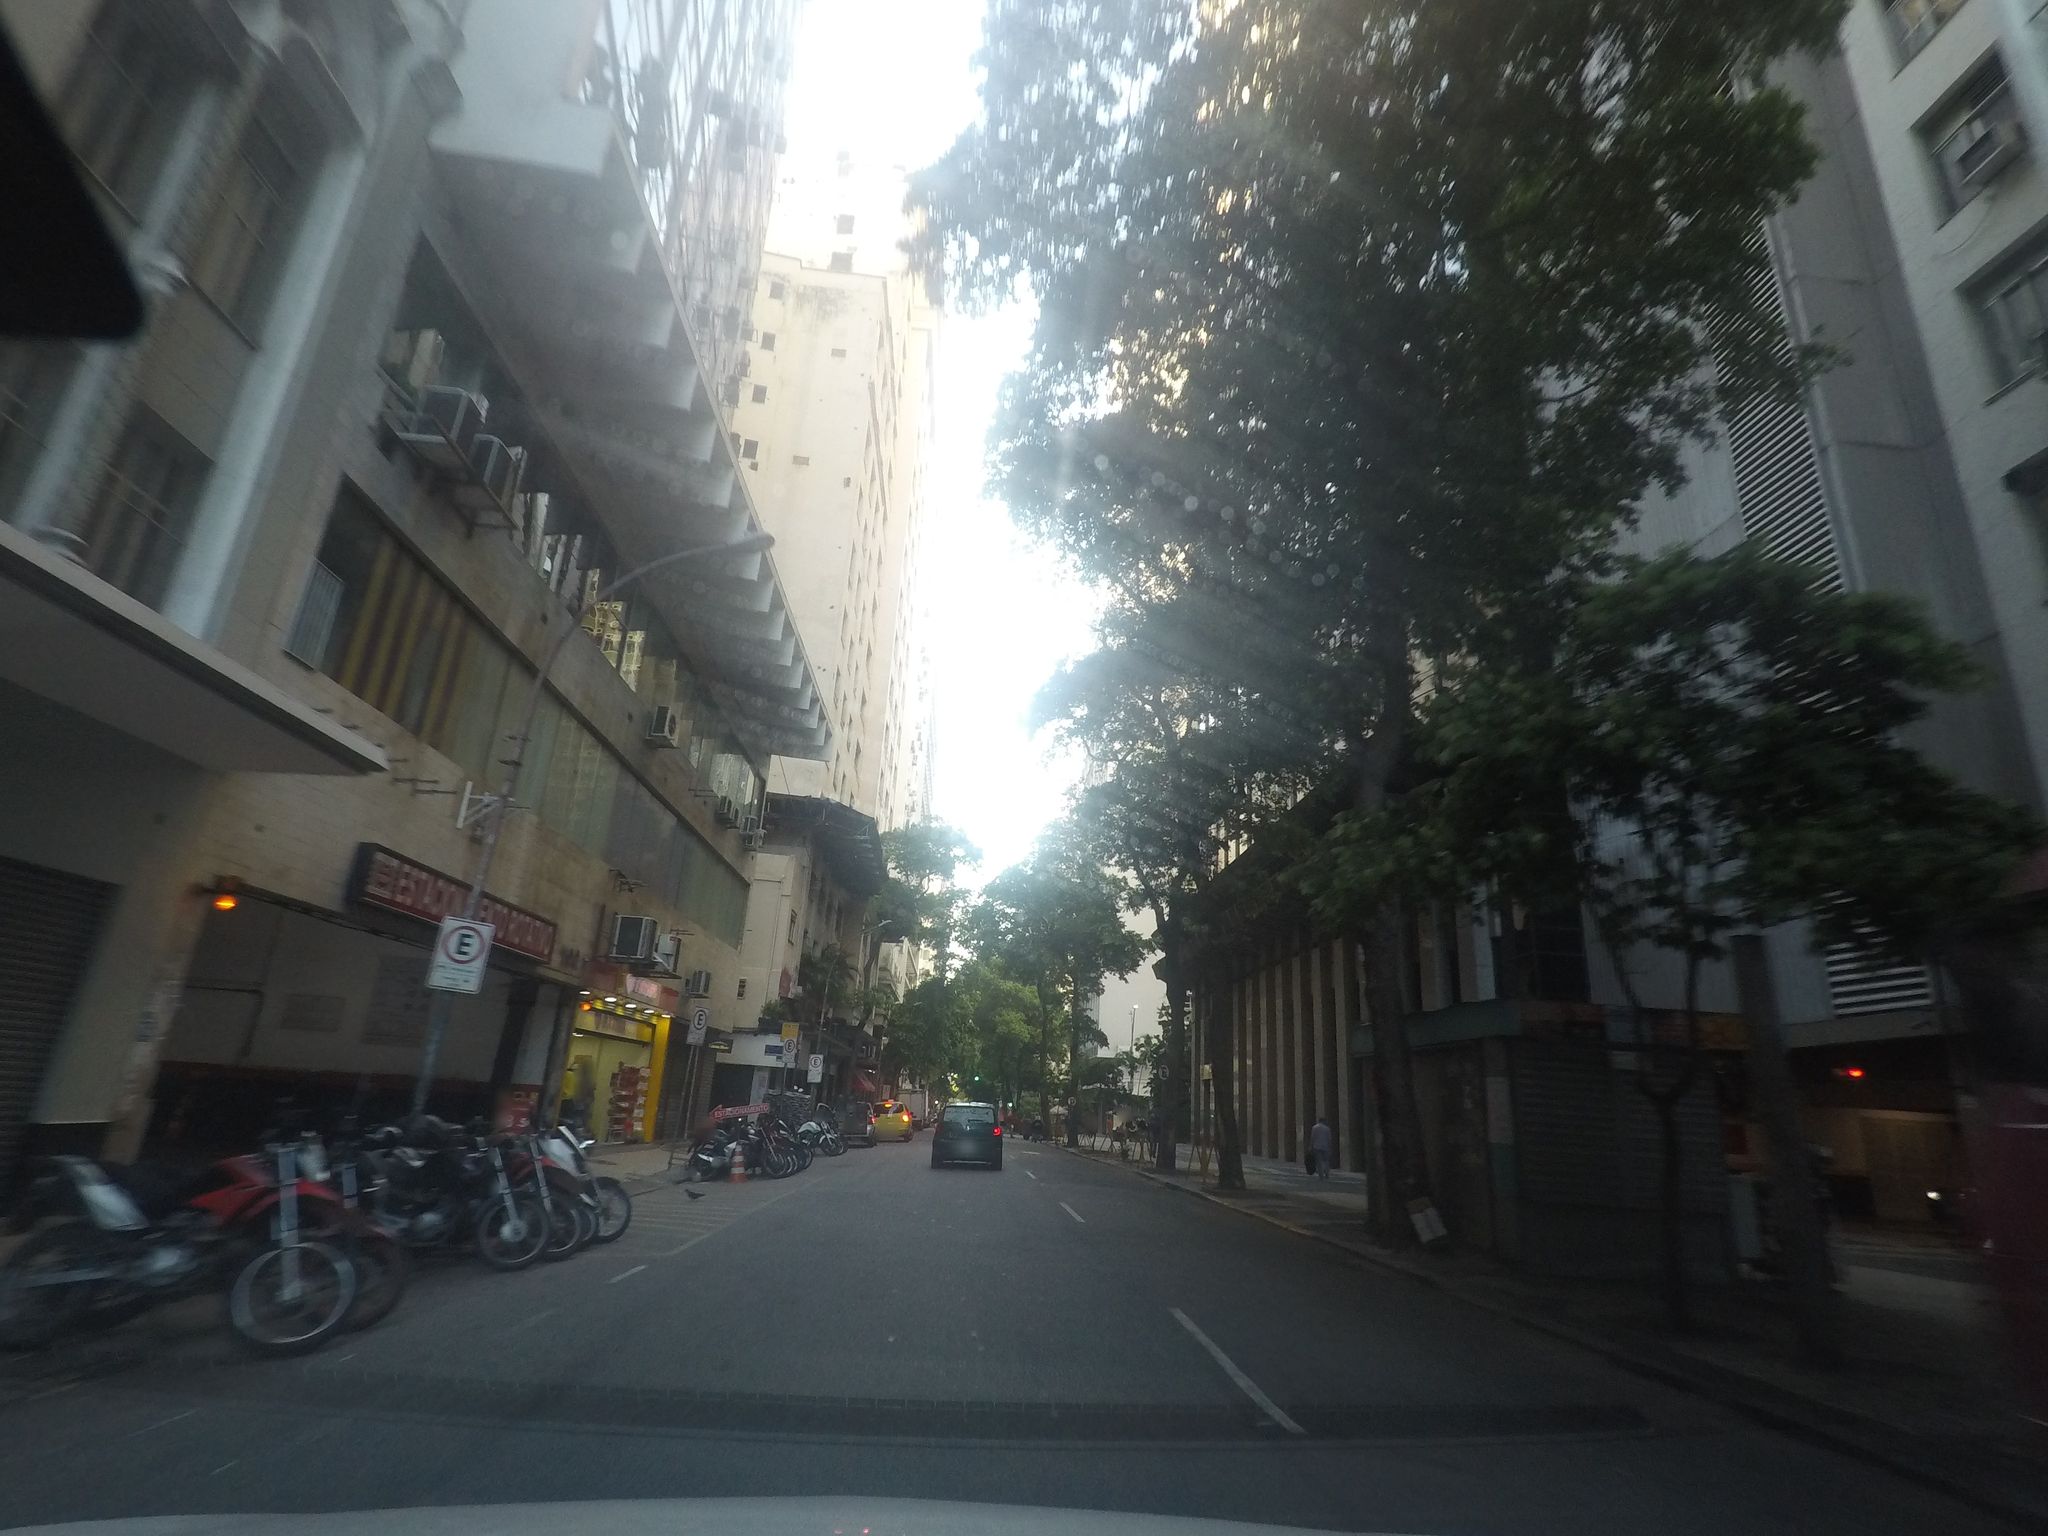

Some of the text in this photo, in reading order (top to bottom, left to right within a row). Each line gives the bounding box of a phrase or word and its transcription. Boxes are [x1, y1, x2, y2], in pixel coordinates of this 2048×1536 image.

[455, 933, 476, 956] E
[697, 1013, 704, 1026] E
[787, 1041, 793, 1051] E
[714, 1105, 769, 1118] ESTACIONAMENTO
